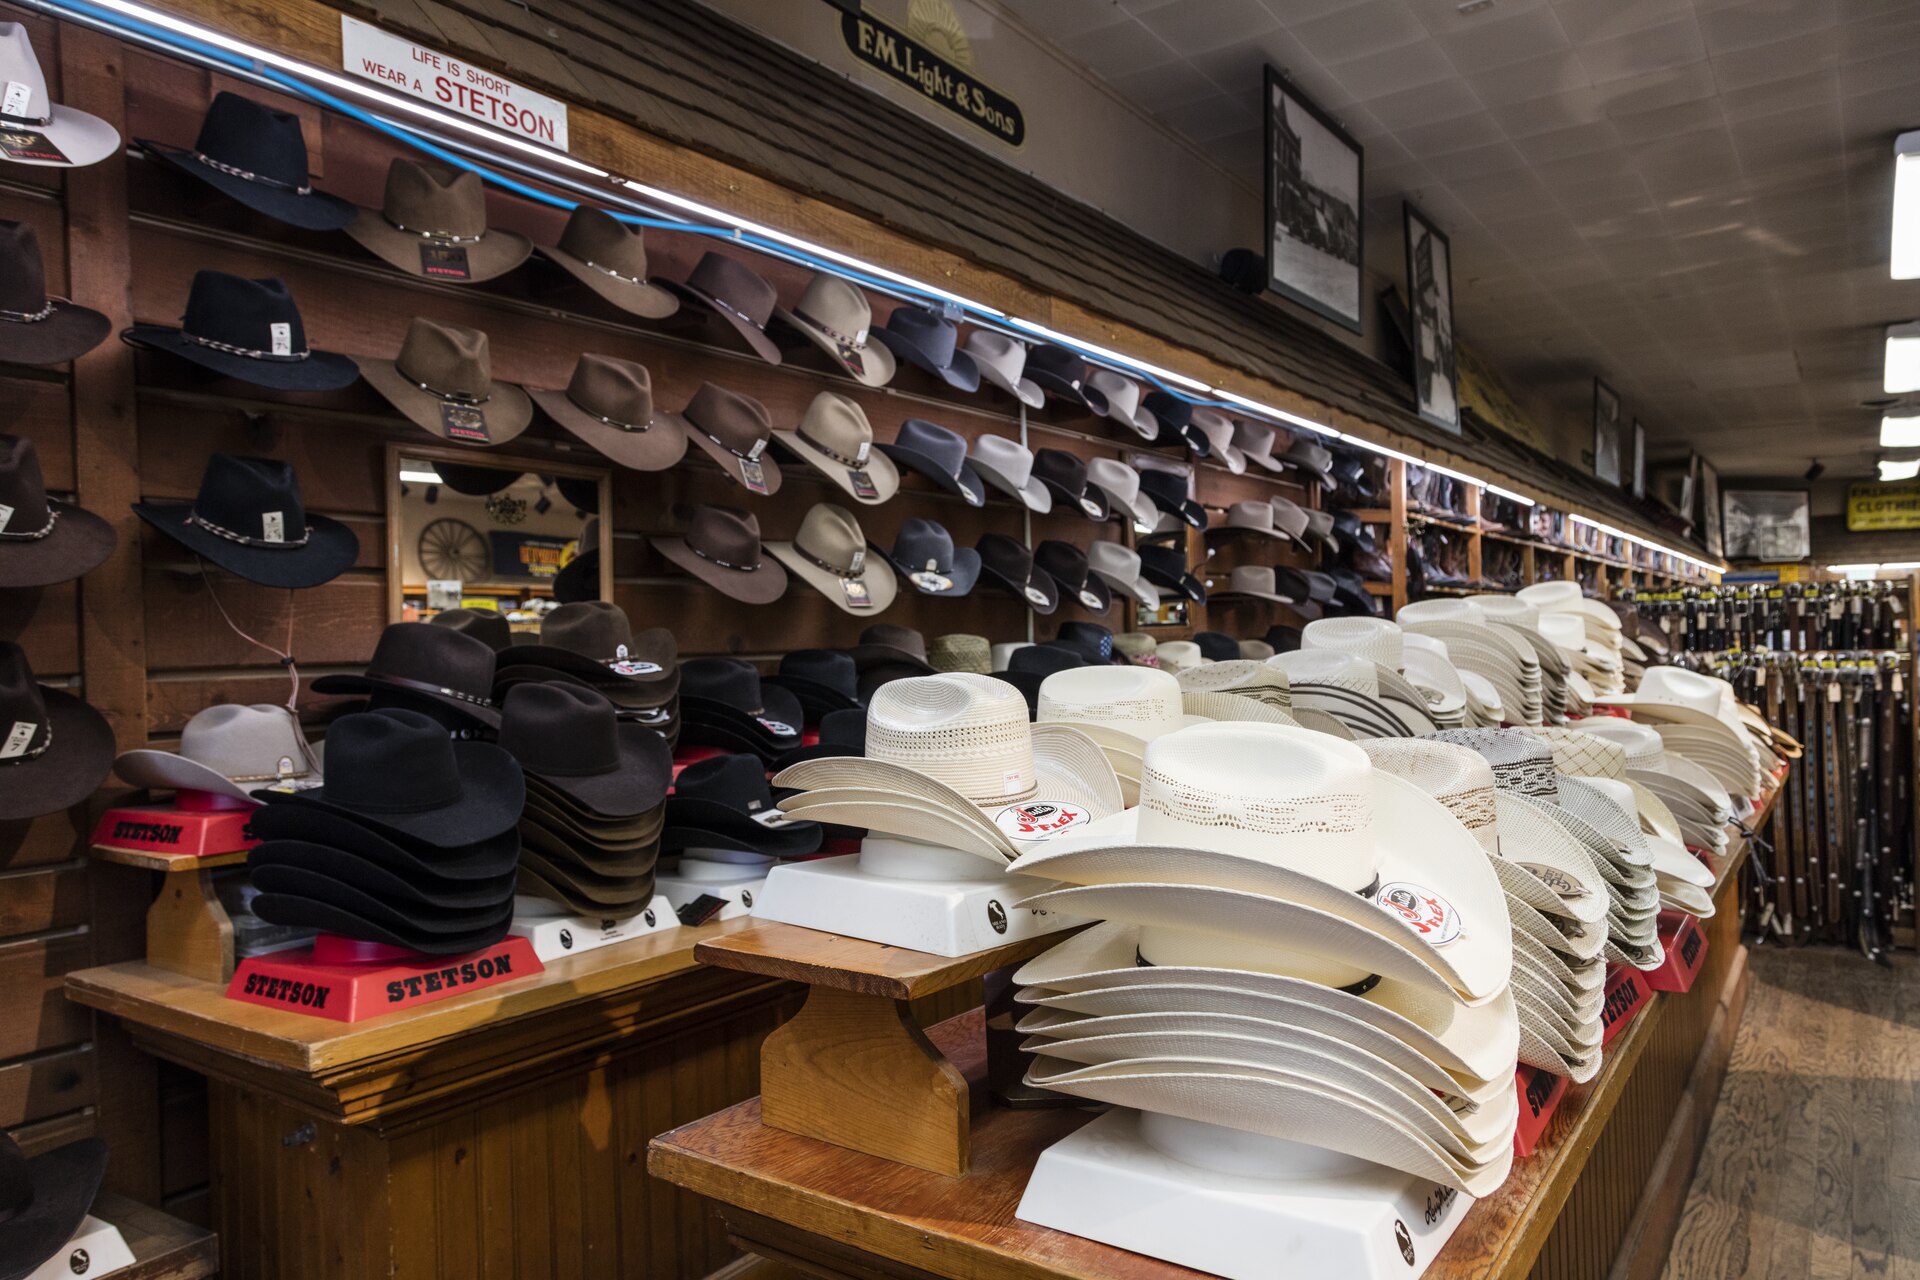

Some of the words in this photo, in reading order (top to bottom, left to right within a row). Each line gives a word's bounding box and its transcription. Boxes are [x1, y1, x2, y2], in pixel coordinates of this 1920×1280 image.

[412, 47, 441, 70] LIFE
[447, 61, 461, 77] IS
[466, 69, 512, 97] SHORT
[362, 58, 407, 87] WEAR
[413, 79, 423, 93] A
[435, 76, 555, 142] STETSON
[956, 82, 970, 111] &
[972, 88, 1016, 136] Sons
[113, 821, 184, 844] STETSON
[1018, 809, 1078, 833] J-FLEX
[244, 973, 330, 1009] STETSON
[386, 954, 512, 1003] STETSON
